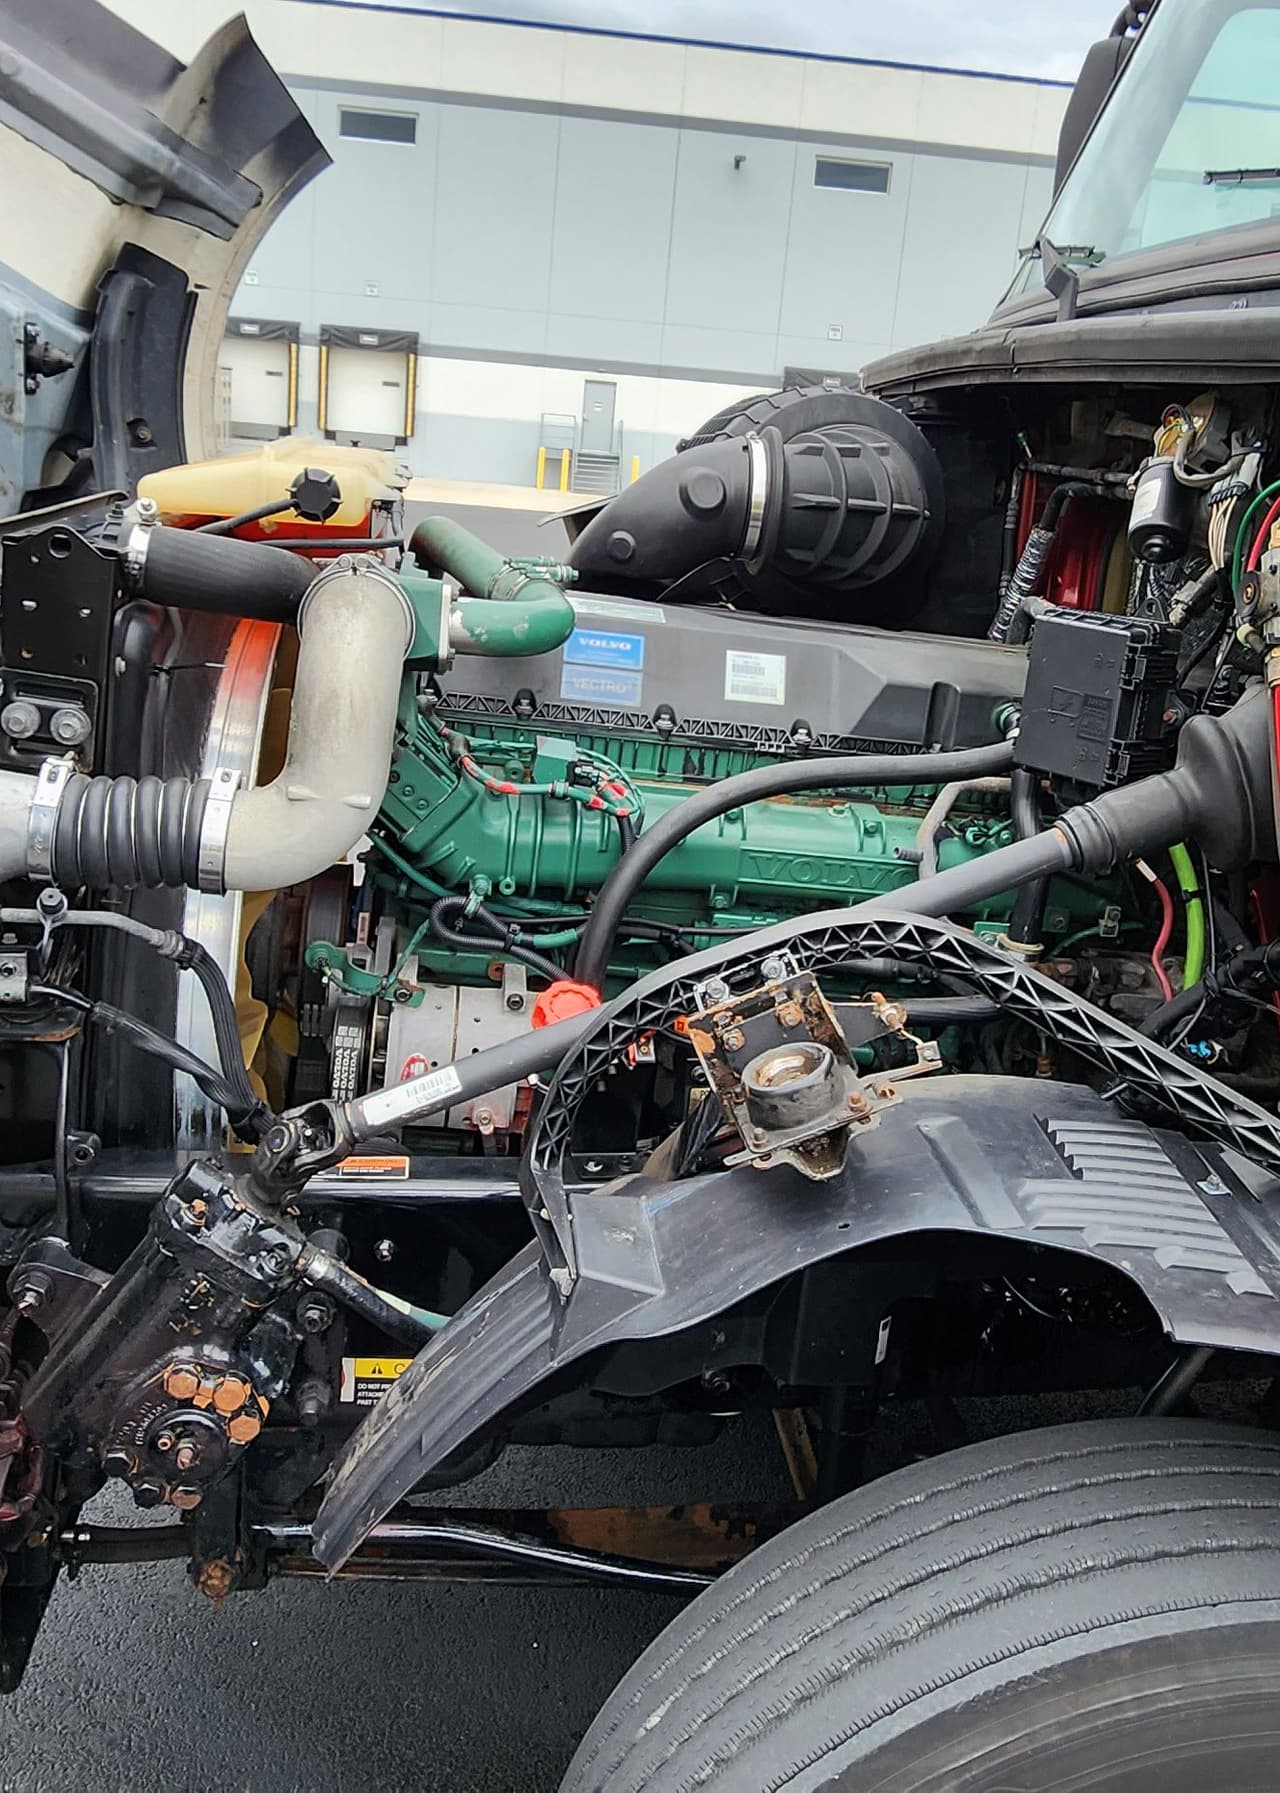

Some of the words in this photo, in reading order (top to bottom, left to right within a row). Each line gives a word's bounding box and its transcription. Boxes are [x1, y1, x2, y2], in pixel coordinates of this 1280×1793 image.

[578, 636, 632, 651] VOLVO
[332, 1047, 343, 1089] VOLVO
[340, 1048, 351, 1089] VOLVO
[348, 1050, 358, 1090] VOLVO
